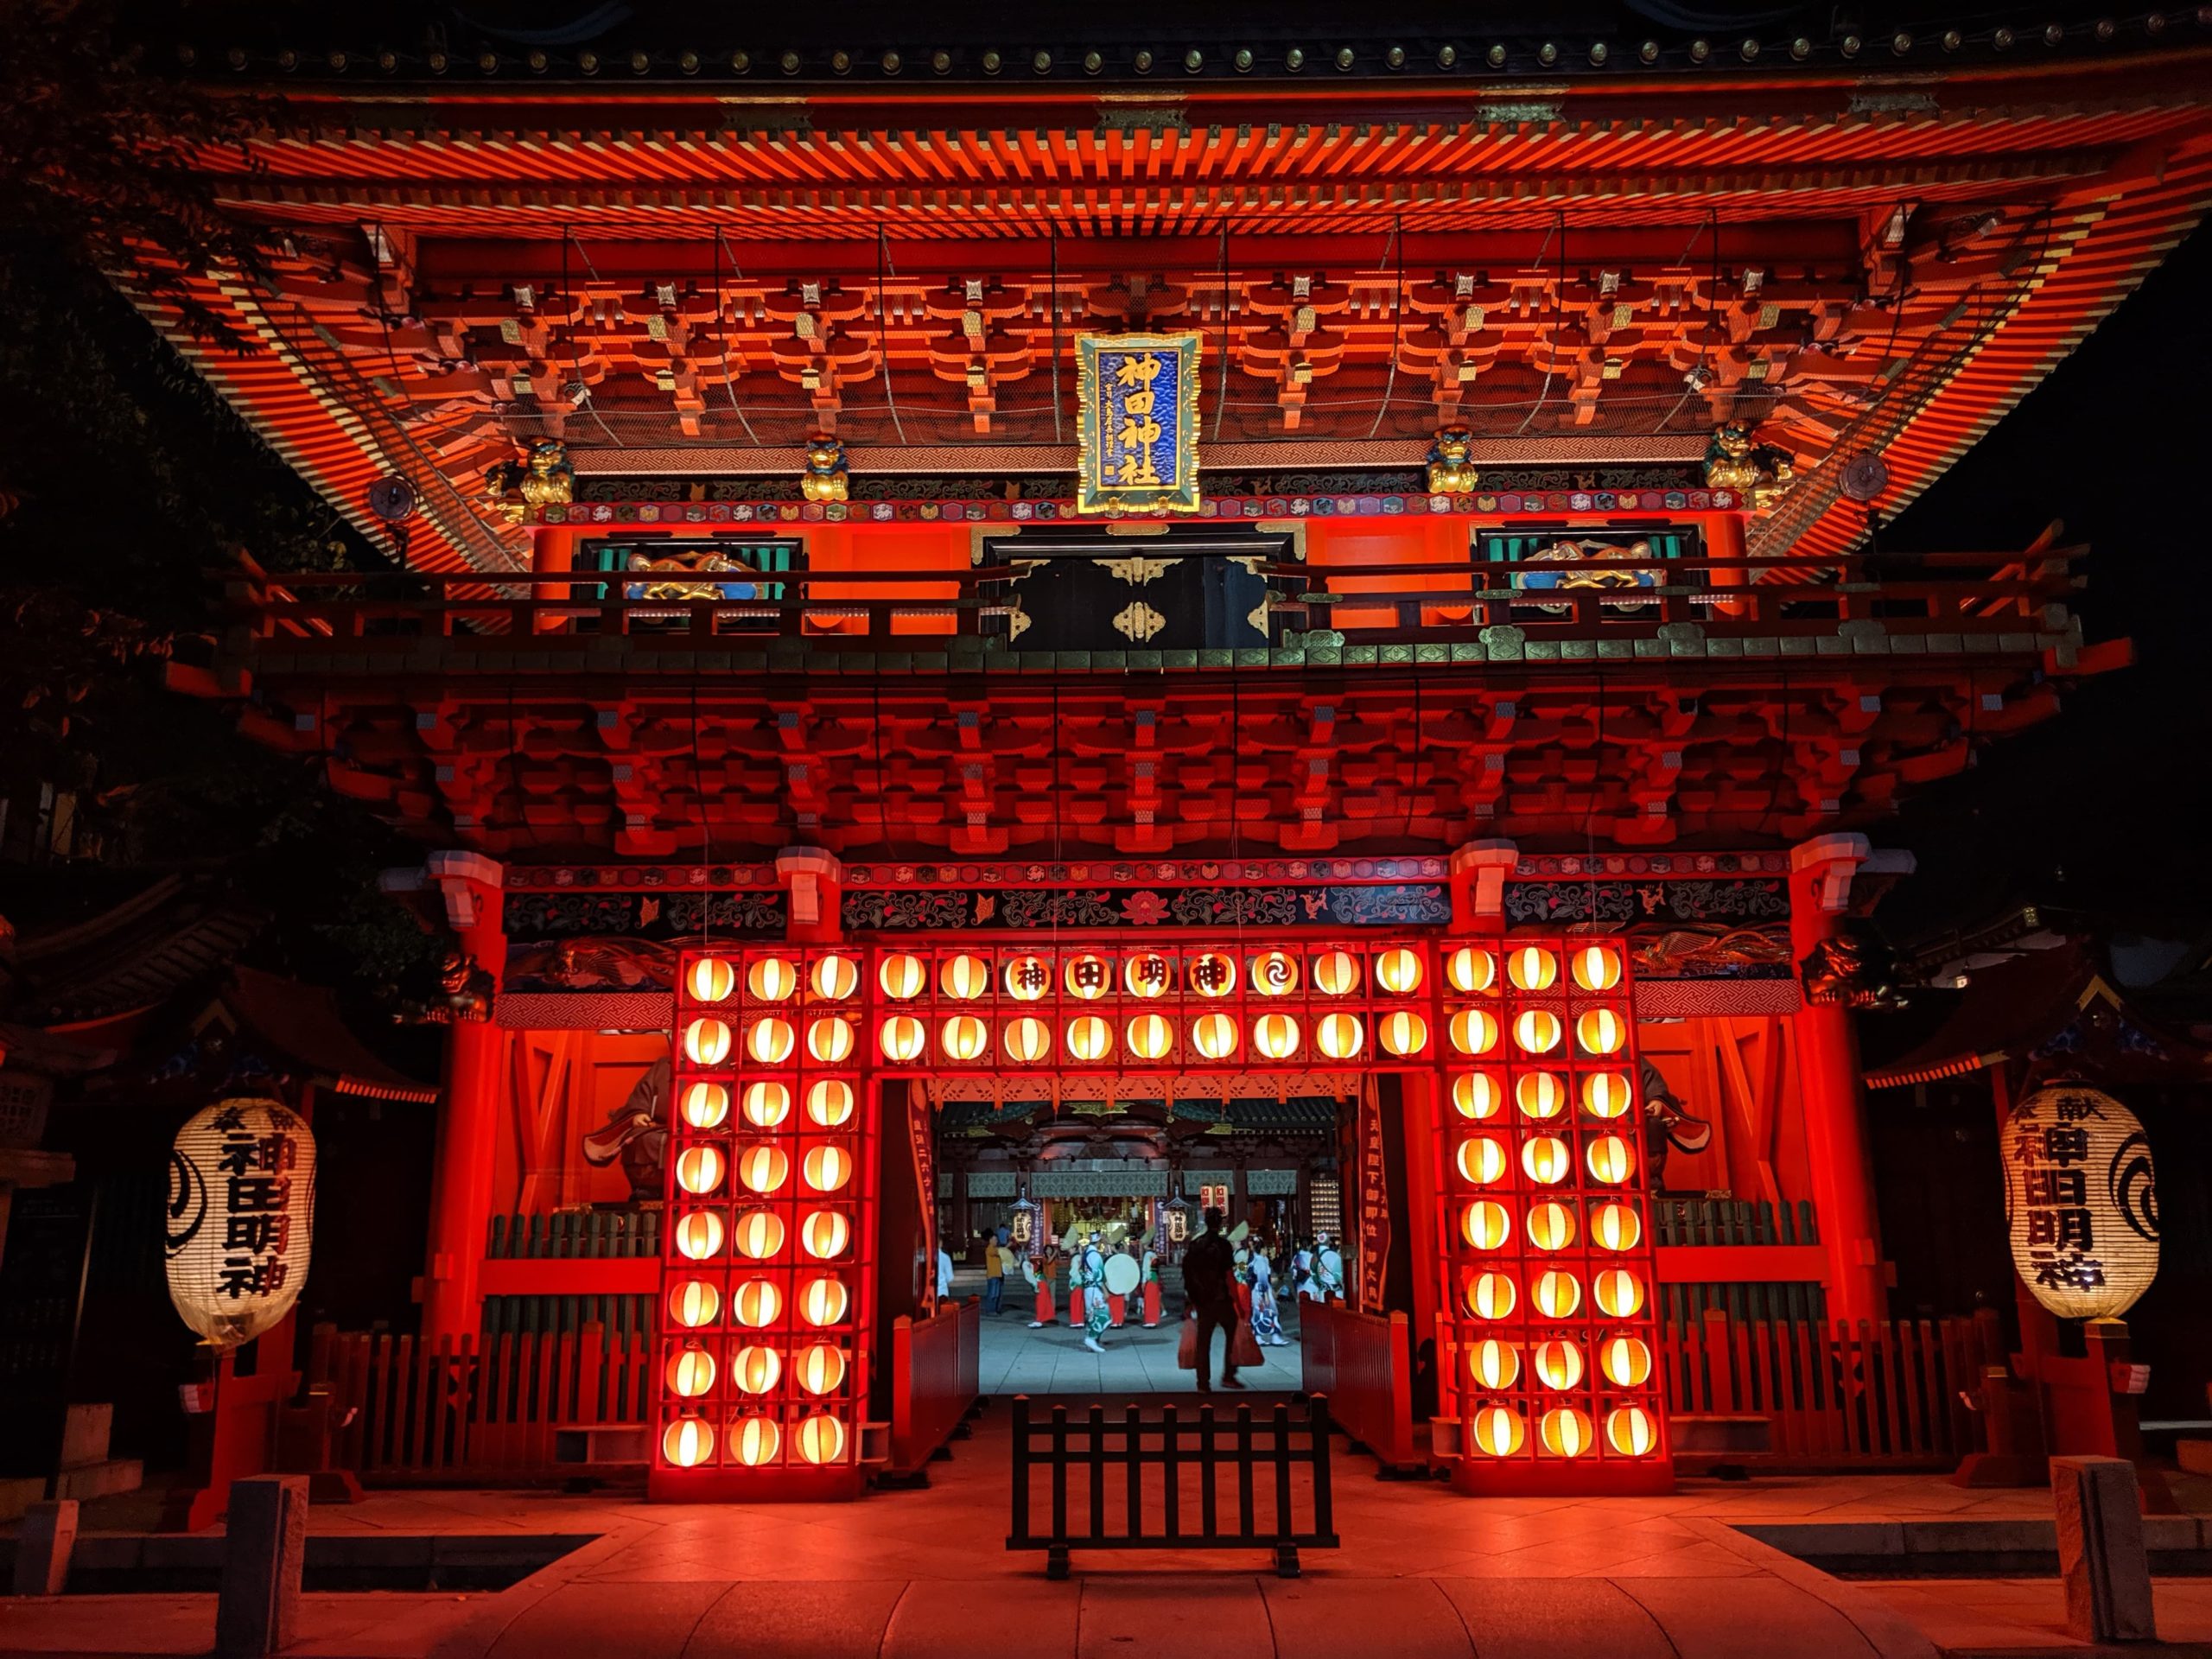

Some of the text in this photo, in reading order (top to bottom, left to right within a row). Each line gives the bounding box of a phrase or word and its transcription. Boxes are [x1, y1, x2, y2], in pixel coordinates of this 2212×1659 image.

[1116, 353, 1161, 486] 神田神社
[216, 1132, 297, 1299] 神田明神
[2014, 1122, 2106, 1294] 神田明神
